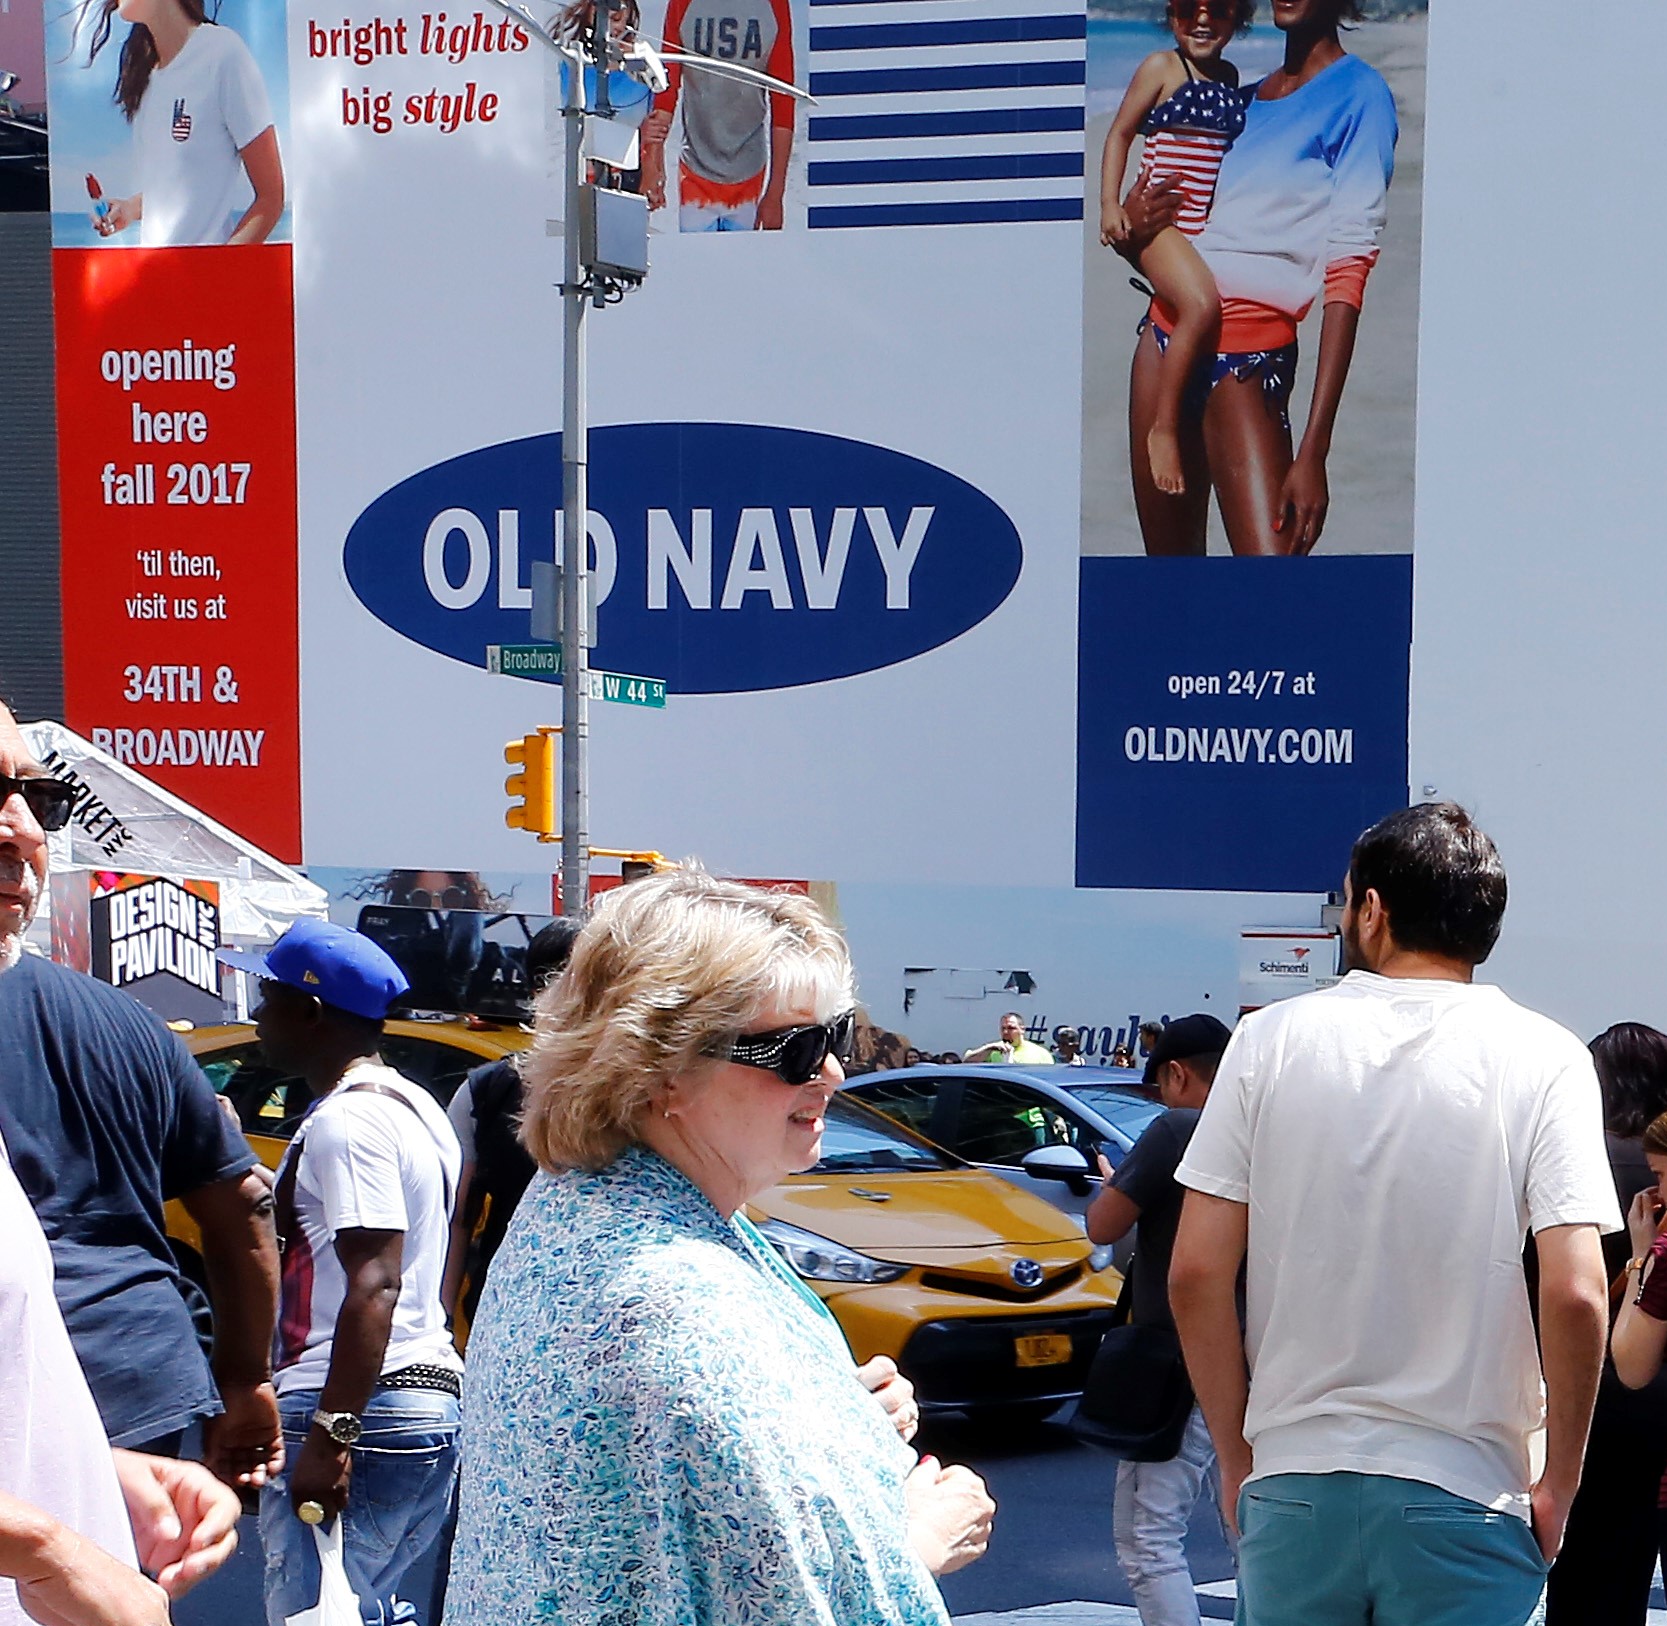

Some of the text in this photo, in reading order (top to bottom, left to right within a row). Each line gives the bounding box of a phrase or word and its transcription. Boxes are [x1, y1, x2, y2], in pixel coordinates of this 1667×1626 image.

[309, 13, 531, 65] bright lights
[693, 18, 762, 60] USA
[342, 83, 499, 133] big style
[101, 339, 237, 391] opening
[132, 402, 208, 443] here
[101, 462, 252, 505] fall 2017
[168, 549, 222, 580] then,
[422, 507, 935, 610] OLD NAVY
[125, 593, 227, 621] visit us at
[503, 650, 561, 674] Broadway
[123, 665, 239, 703] 34TH &
[605, 677, 664, 703] W 44 St
[1168, 670, 1316, 702] open 24/7 at
[91, 727, 266, 768] BROADWAY
[1124, 727, 1354, 766] OLDNAVY.COM
[102, 827, 133, 858] NYC
[110, 880, 198, 941] DESIGN
[199, 900, 217, 950] NYC
[111, 928, 220, 997] PAVILION
[1260, 961, 1309, 973] Schimenti
